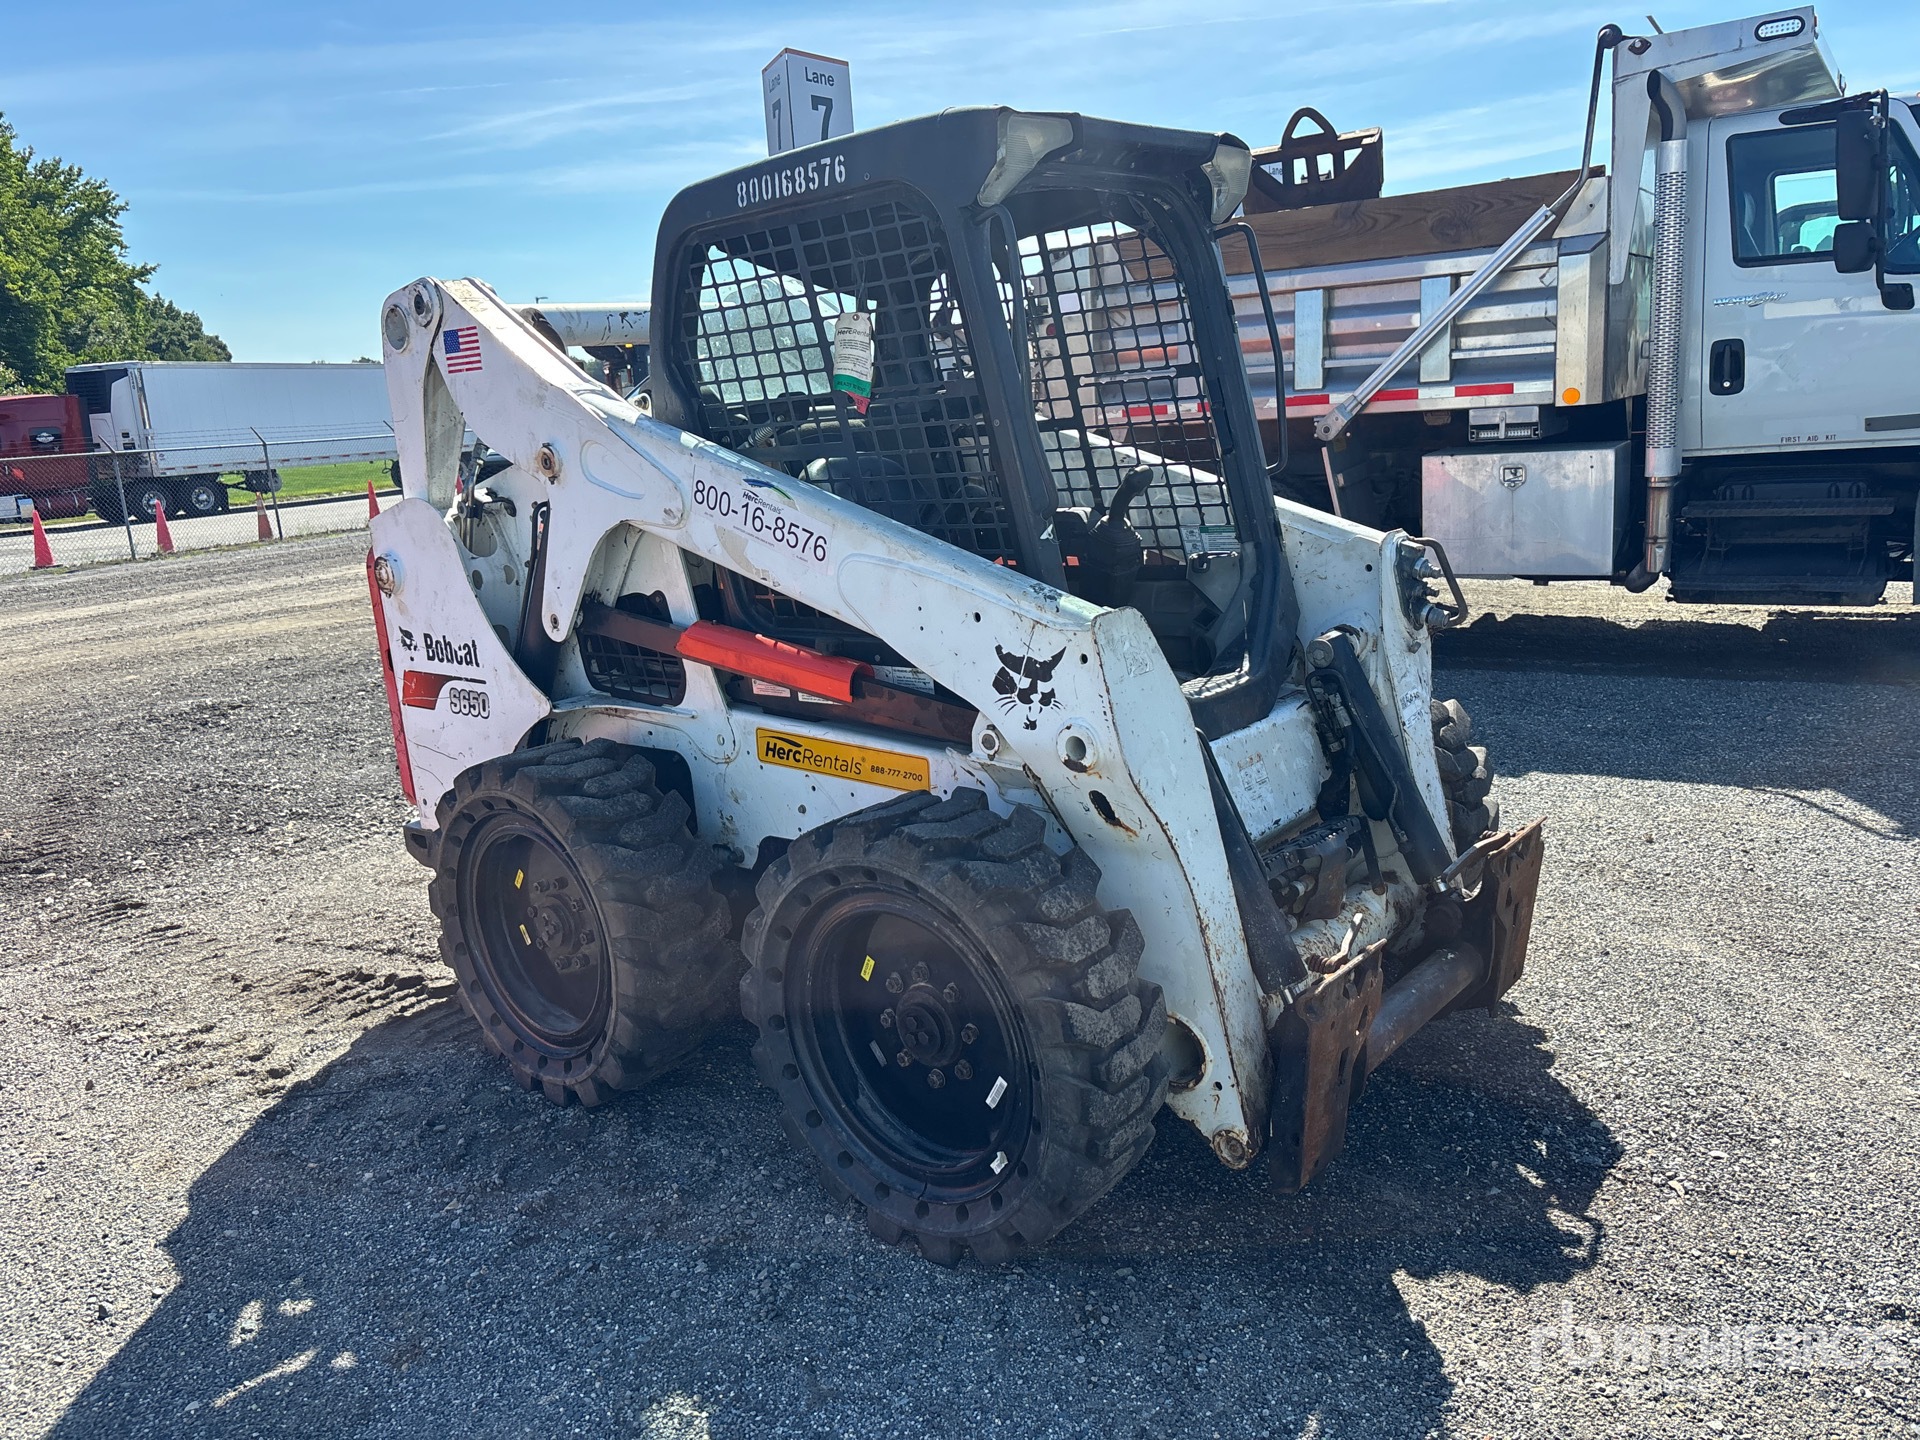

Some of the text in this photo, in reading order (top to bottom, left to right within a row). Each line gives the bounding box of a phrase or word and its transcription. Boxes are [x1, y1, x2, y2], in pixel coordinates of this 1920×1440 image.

[768, 74, 781, 93] Lane
[804, 67, 835, 87] Lane
[772, 98, 781, 150] 7
[811, 94, 834, 141] 7
[737, 154, 846, 208] 800168576
[1780, 433, 1837, 443] FIRST AID KIT
[742, 490, 785, 515] HercRentals
[693, 479, 828, 562] 800-16-8576
[423, 632, 481, 668] Bobcat
[449, 687, 490, 720] S650
[870, 764, 923, 782] 888-777-2700
